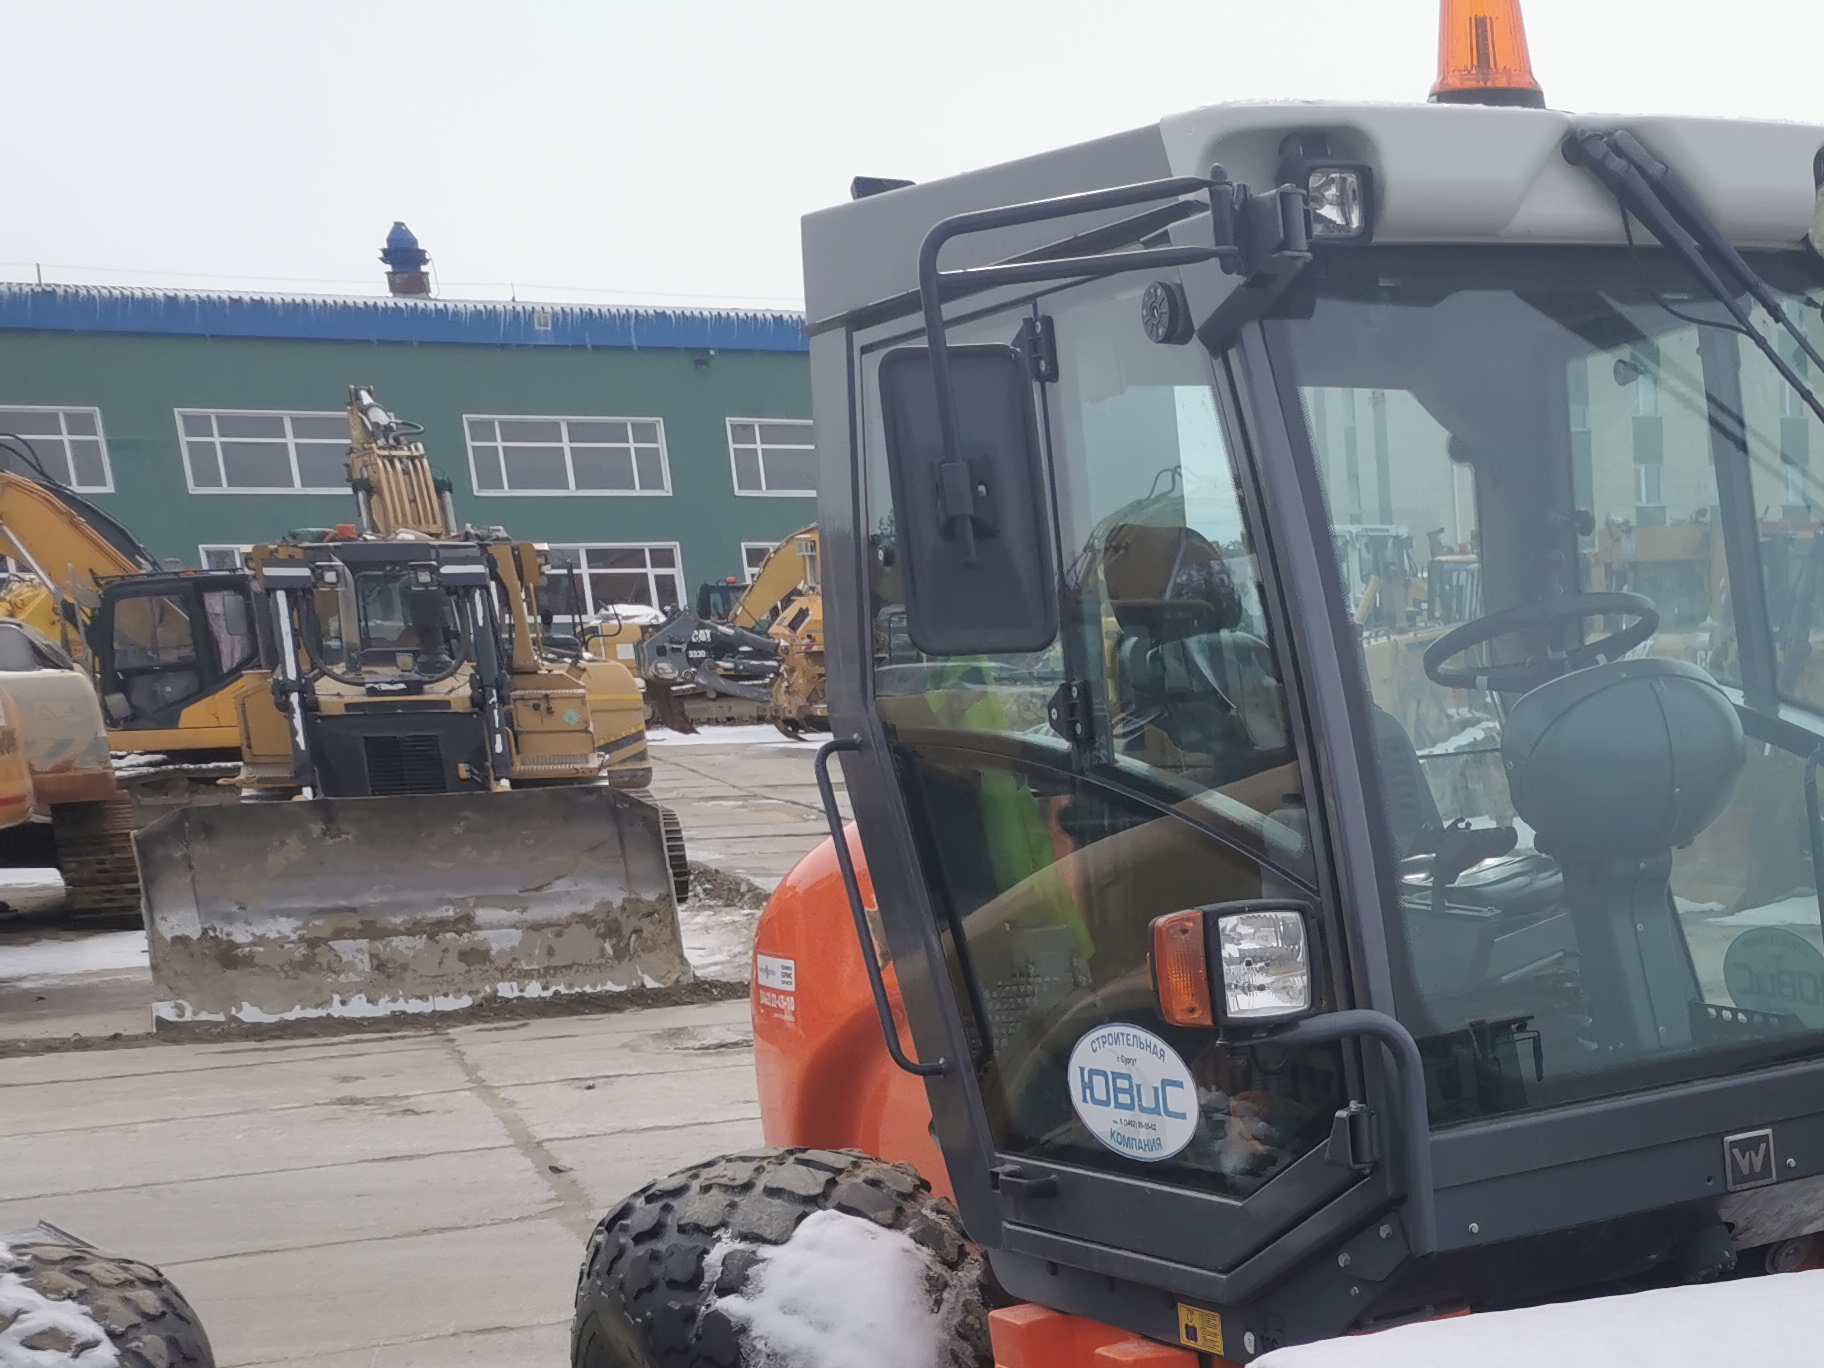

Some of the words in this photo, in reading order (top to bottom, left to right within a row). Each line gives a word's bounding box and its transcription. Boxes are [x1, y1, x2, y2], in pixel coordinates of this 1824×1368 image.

[691, 629, 712, 643] CAT
[1090, 1032, 1166, 1063] СТРОИТЕЛЬНАЯ
[1078, 1066, 1188, 1121] ЮВиС
[1110, 1127, 1163, 1153] КОМПАНИЯ
